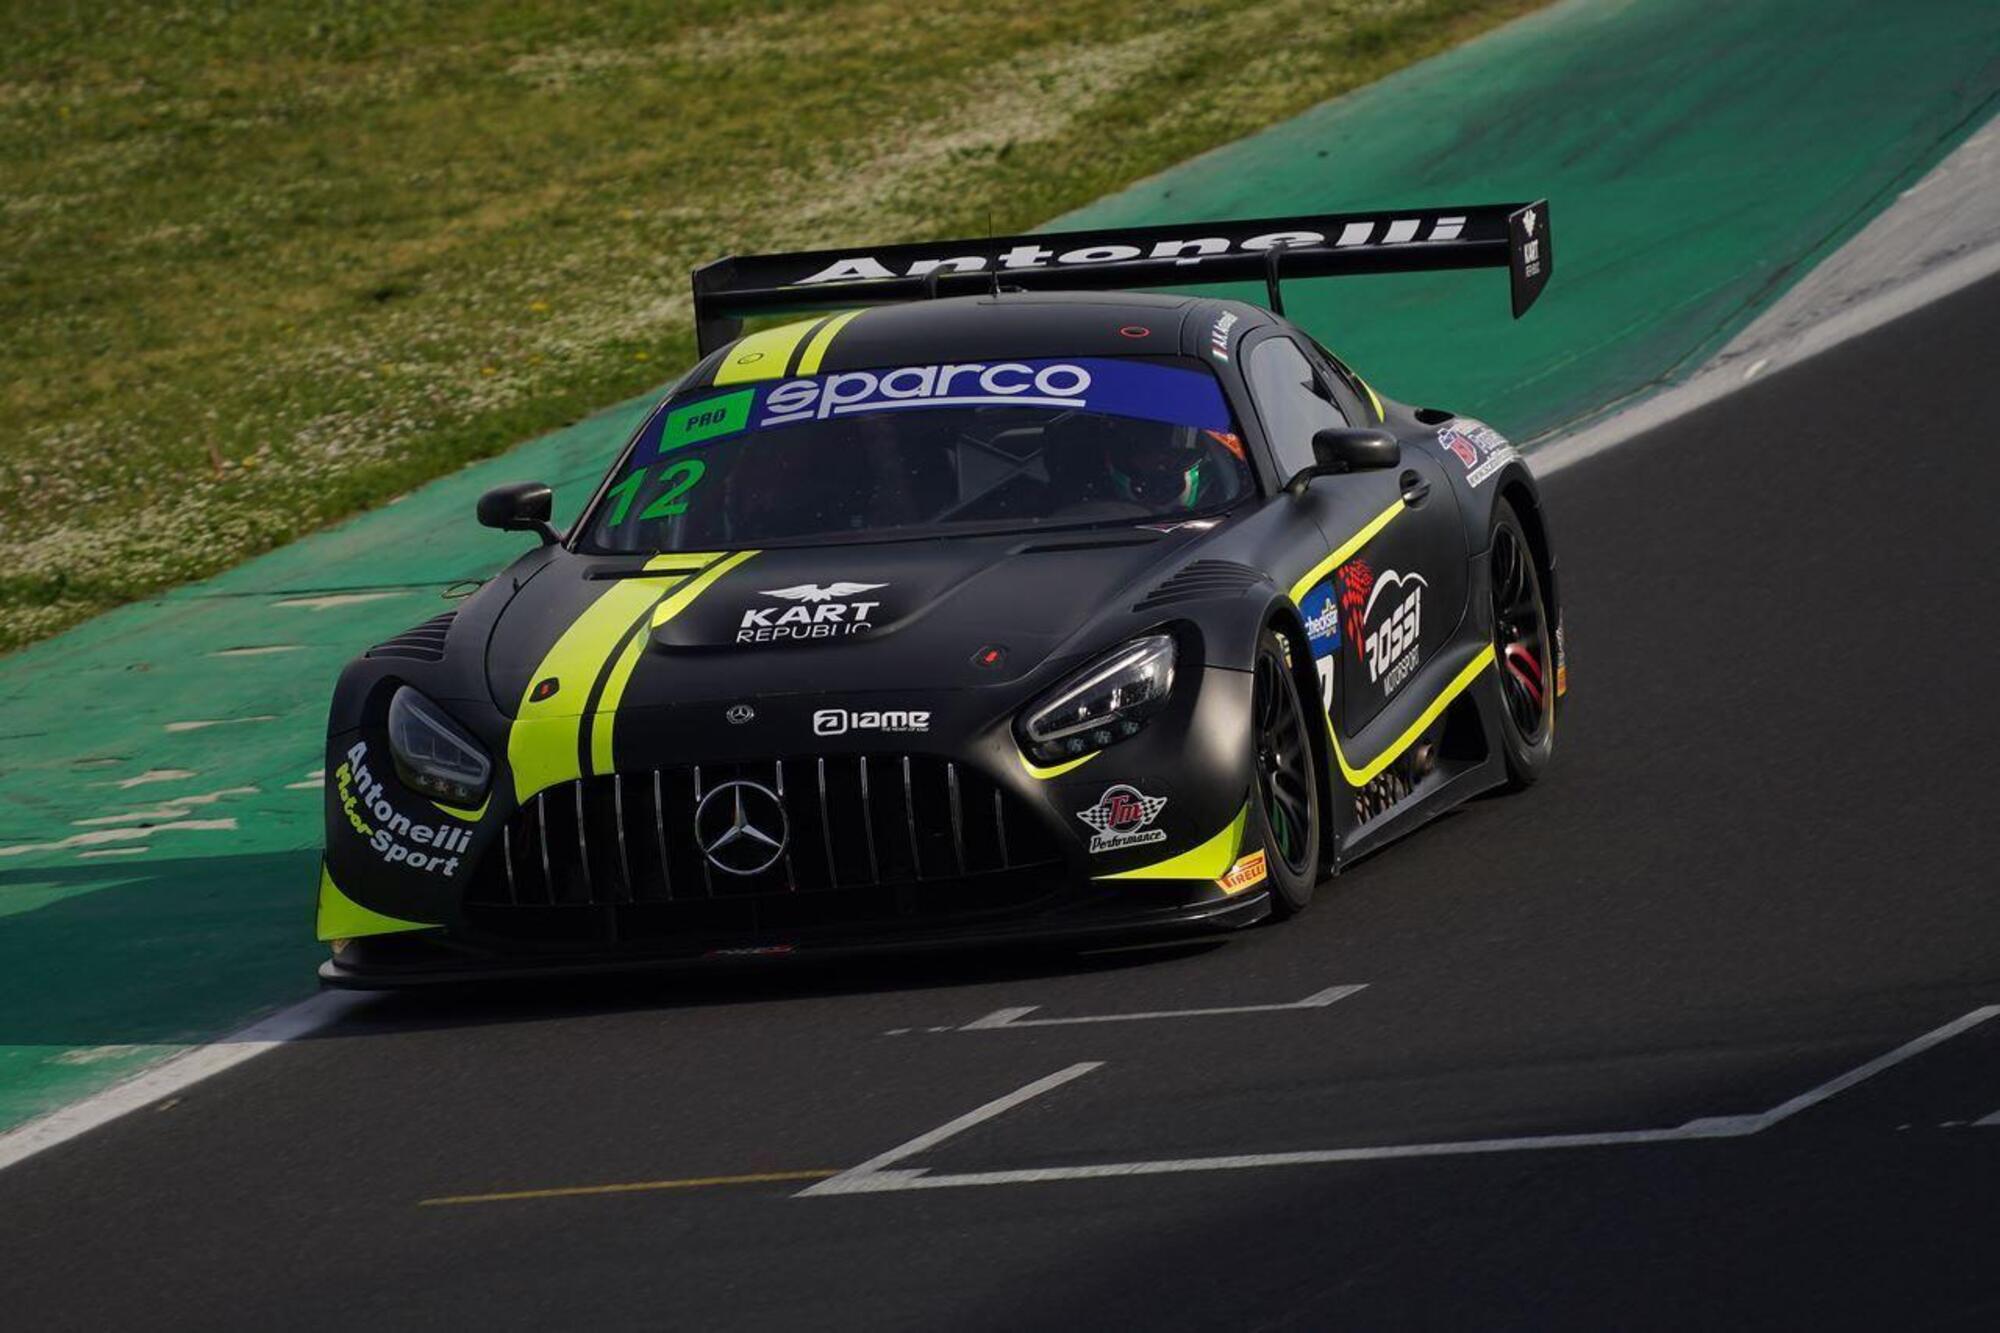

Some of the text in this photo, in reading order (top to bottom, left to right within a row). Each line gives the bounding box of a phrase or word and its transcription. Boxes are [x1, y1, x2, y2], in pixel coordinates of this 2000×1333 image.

[792, 216, 1467, 284] Antonelli
[686, 408, 727, 432] PRO
[766, 363, 1092, 419] sparco
[607, 459, 706, 527] 12
[741, 602, 880, 628] KART
[347, 741, 473, 854] Antonelli
